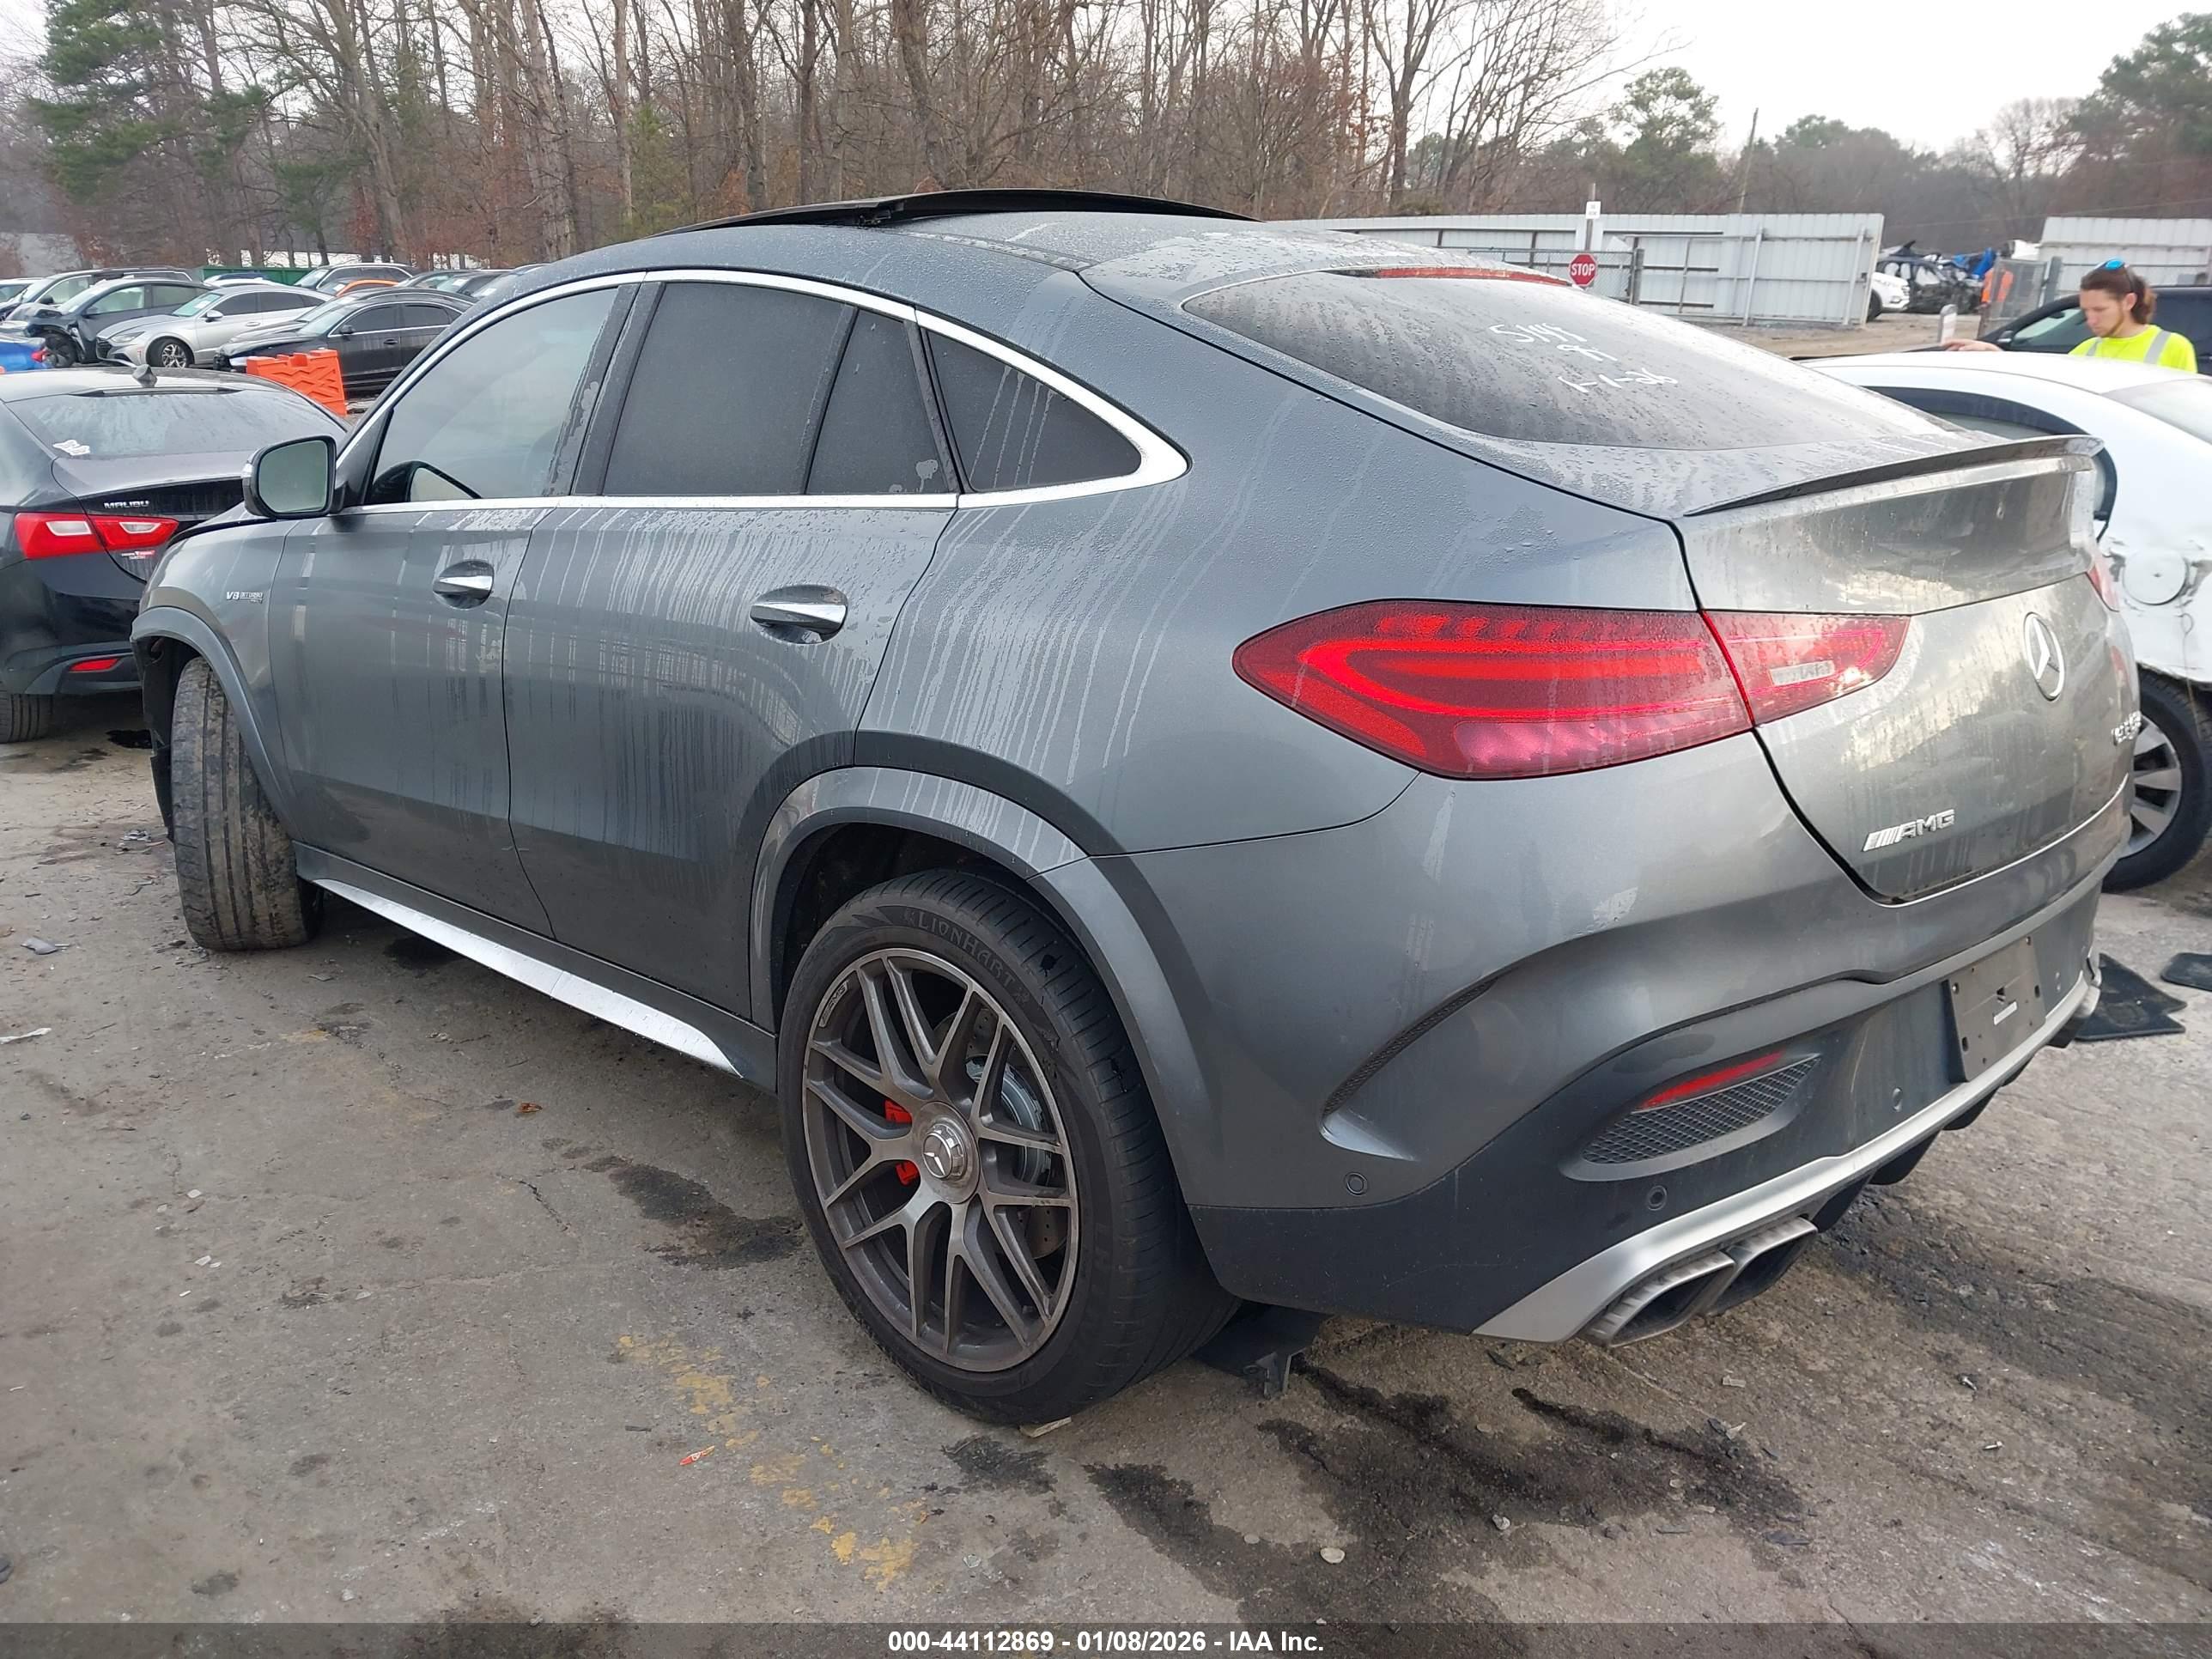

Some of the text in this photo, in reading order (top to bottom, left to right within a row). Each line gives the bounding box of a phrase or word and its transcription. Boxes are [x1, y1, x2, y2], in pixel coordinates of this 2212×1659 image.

[1571, 264, 1595, 276] STOP
[226, 591, 240, 600] V8
[919, 911, 1014, 987] LIONHART
